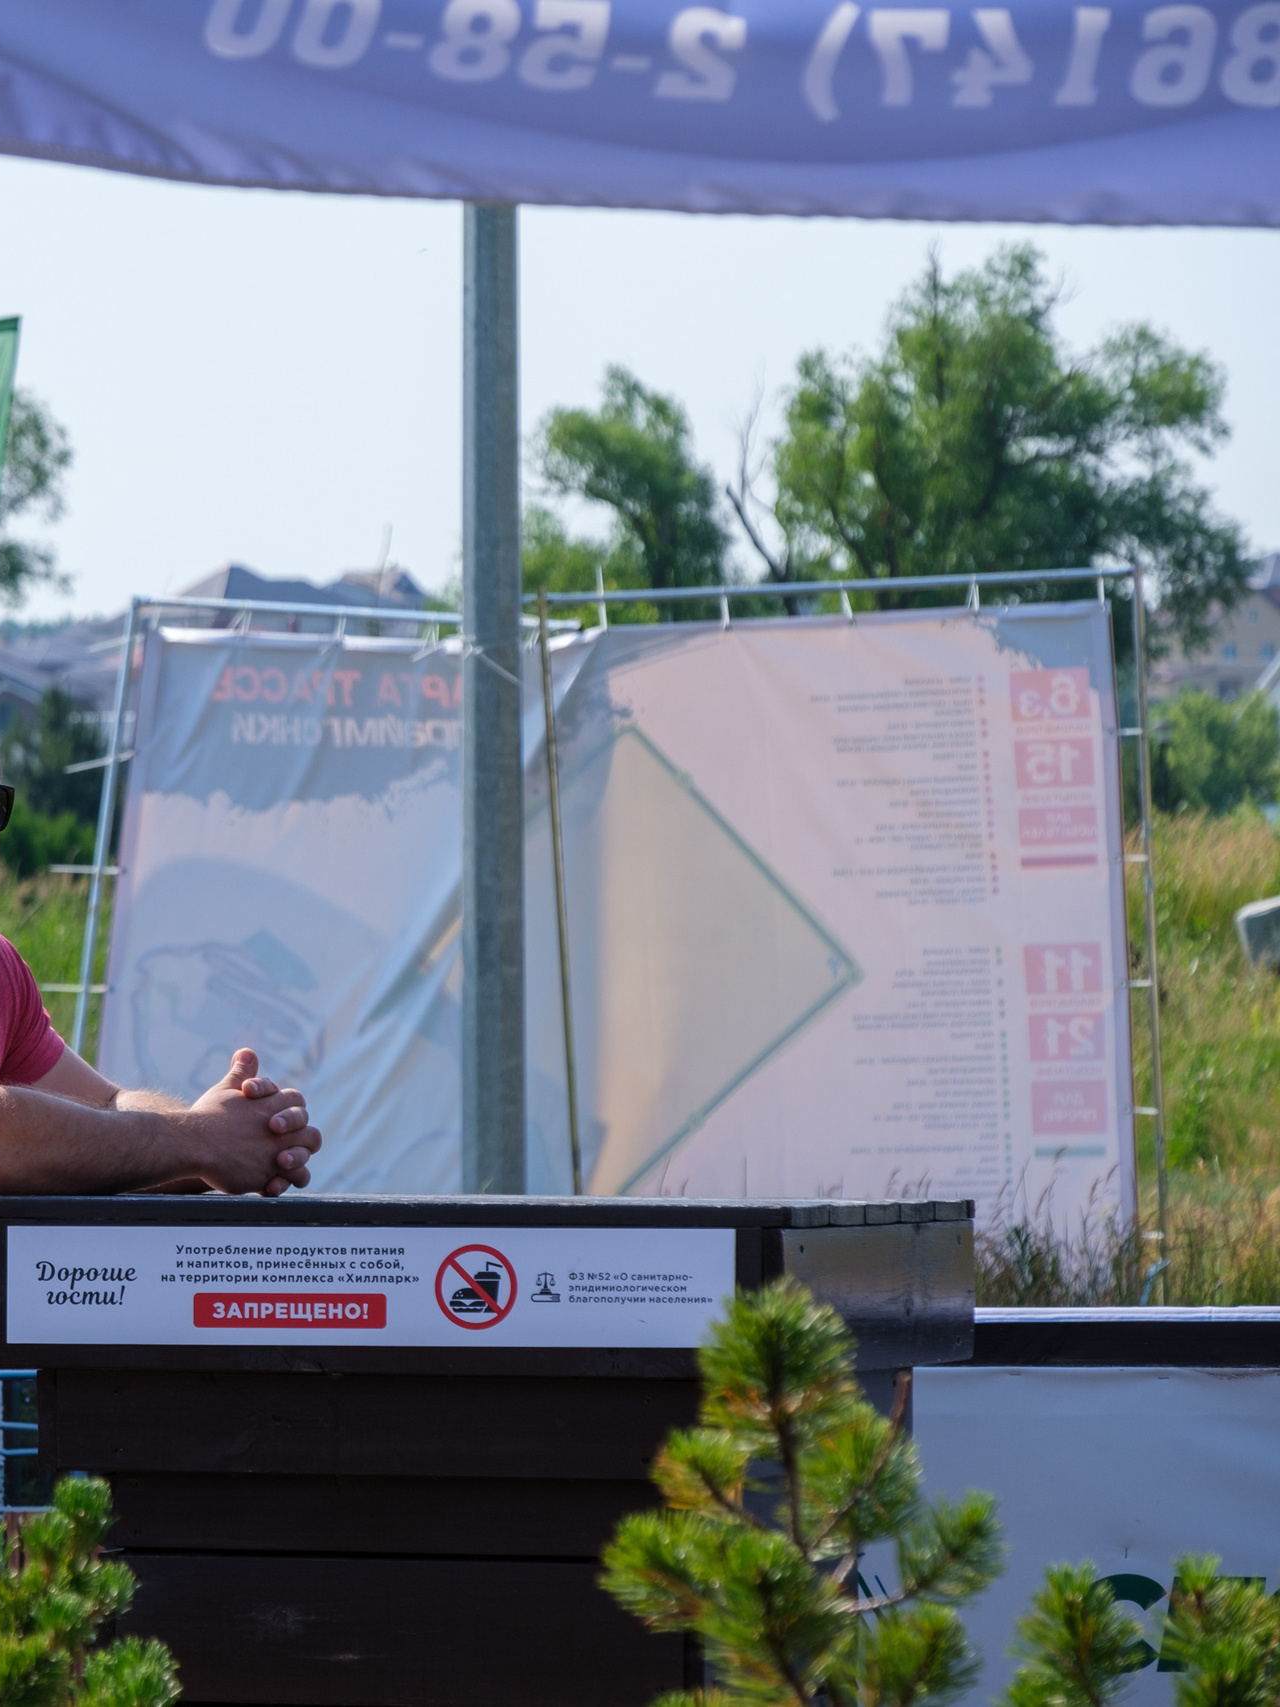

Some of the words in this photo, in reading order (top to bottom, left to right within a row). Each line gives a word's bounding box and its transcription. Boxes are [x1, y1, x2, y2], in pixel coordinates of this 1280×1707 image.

[176, 1245, 272, 1257] Употребление
[276, 1246, 347, 1257] продуктов
[351, 1247, 405, 1256] питания
[176, 1260, 184, 1268] и
[187, 1260, 253, 1270] напитков,
[256, 1258, 346, 1271] принесённых
[349, 1261, 356, 1269] с
[360, 1259, 405, 1271] собой,
[35, 1260, 138, 1290] Дорогие
[161, 1274, 176, 1282] на
[179, 1273, 258, 1284] территории
[262, 1274, 334, 1283] комплекса
[338, 1273, 420, 1285] «Хиллпарк»
[568, 1271, 585, 1281] ФЗ
[587, 1272, 611, 1281] №52
[613, 1272, 628, 1281] «О
[631, 1274, 693, 1283] санитарно-
[46, 1285, 126, 1305] гости!
[568, 1285, 687, 1293] эпидимиологическом
[568, 1295, 647, 1305] благополучии
[649, 1296, 713, 1304] населения»
[212, 1301, 369, 1322] ЗАПРЕЩЕНО!
